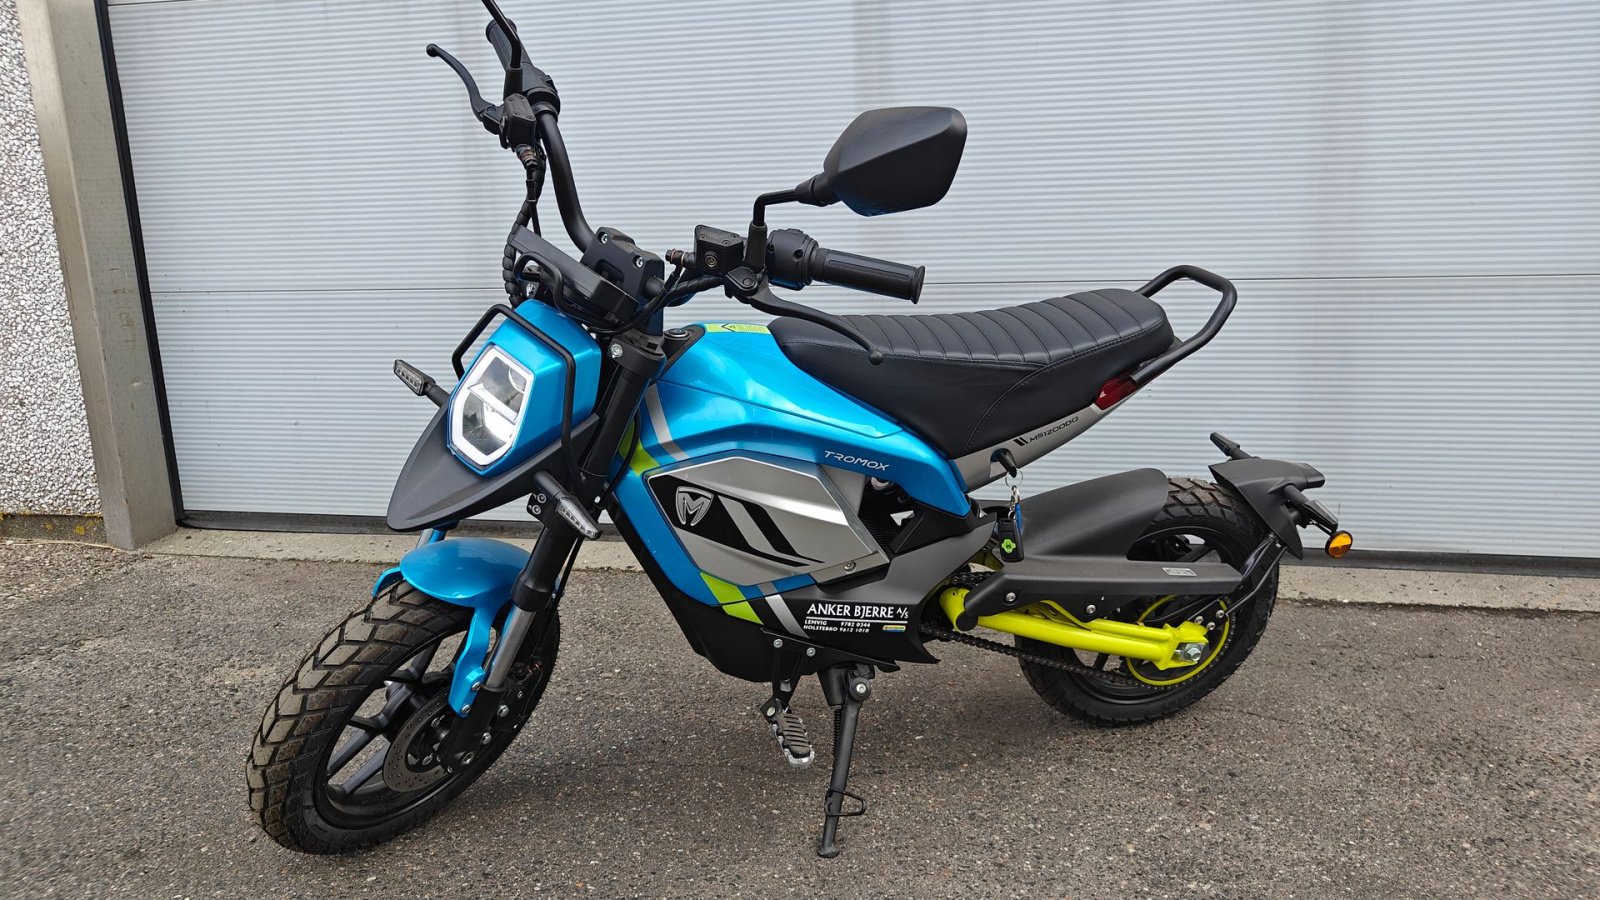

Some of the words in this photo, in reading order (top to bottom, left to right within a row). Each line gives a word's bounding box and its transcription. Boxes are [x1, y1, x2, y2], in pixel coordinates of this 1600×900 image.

[824, 450, 890, 471] TROMOX
[806, 603, 851, 617] ANKER
[854, 605, 894, 619] BJERRE
[896, 607, 909, 619] A/S
